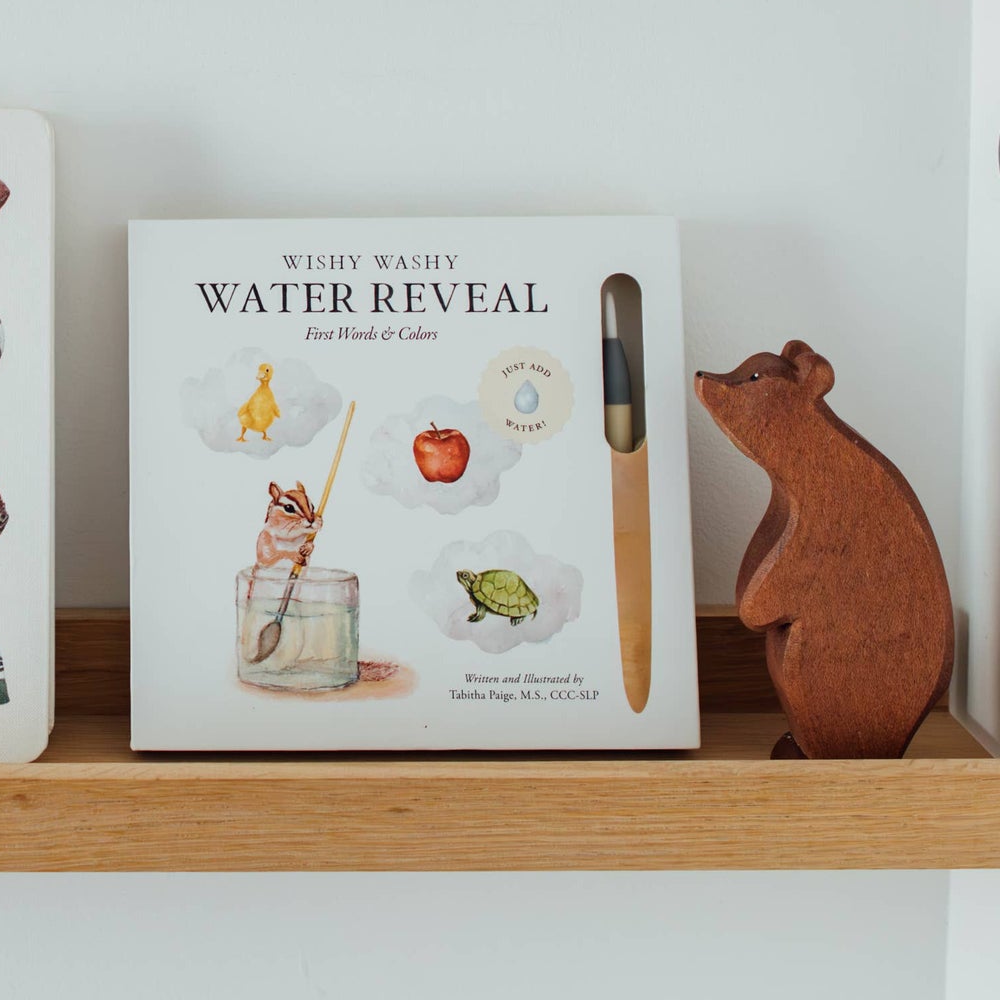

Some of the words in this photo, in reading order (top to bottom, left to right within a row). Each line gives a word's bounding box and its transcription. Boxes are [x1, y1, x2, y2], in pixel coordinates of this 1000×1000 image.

[282, 254, 362, 271] WISHY
[374, 254, 459, 271] WASHY
[195, 281, 358, 314] WATER
[371, 281, 549, 314] REVEAL
[305, 325, 335, 343] First
[338, 325, 378, 341] Words
[381, 325, 396, 341] &
[398, 325, 438, 342] Colors
[501, 362, 525, 378] JUST
[529, 363, 552, 378] ADD
[505, 418, 547, 432] WATER!
[465, 673, 499, 684] Written
[502, 673, 521, 684] and
[523, 673, 570, 684] Illustrated
[573, 673, 584, 686] by
[449, 690, 486, 700] Tabitha
[489, 690, 517, 702] Paige,
[520, 690, 547, 701] M.S.,
[550, 690, 600, 700] CCC-SLP
